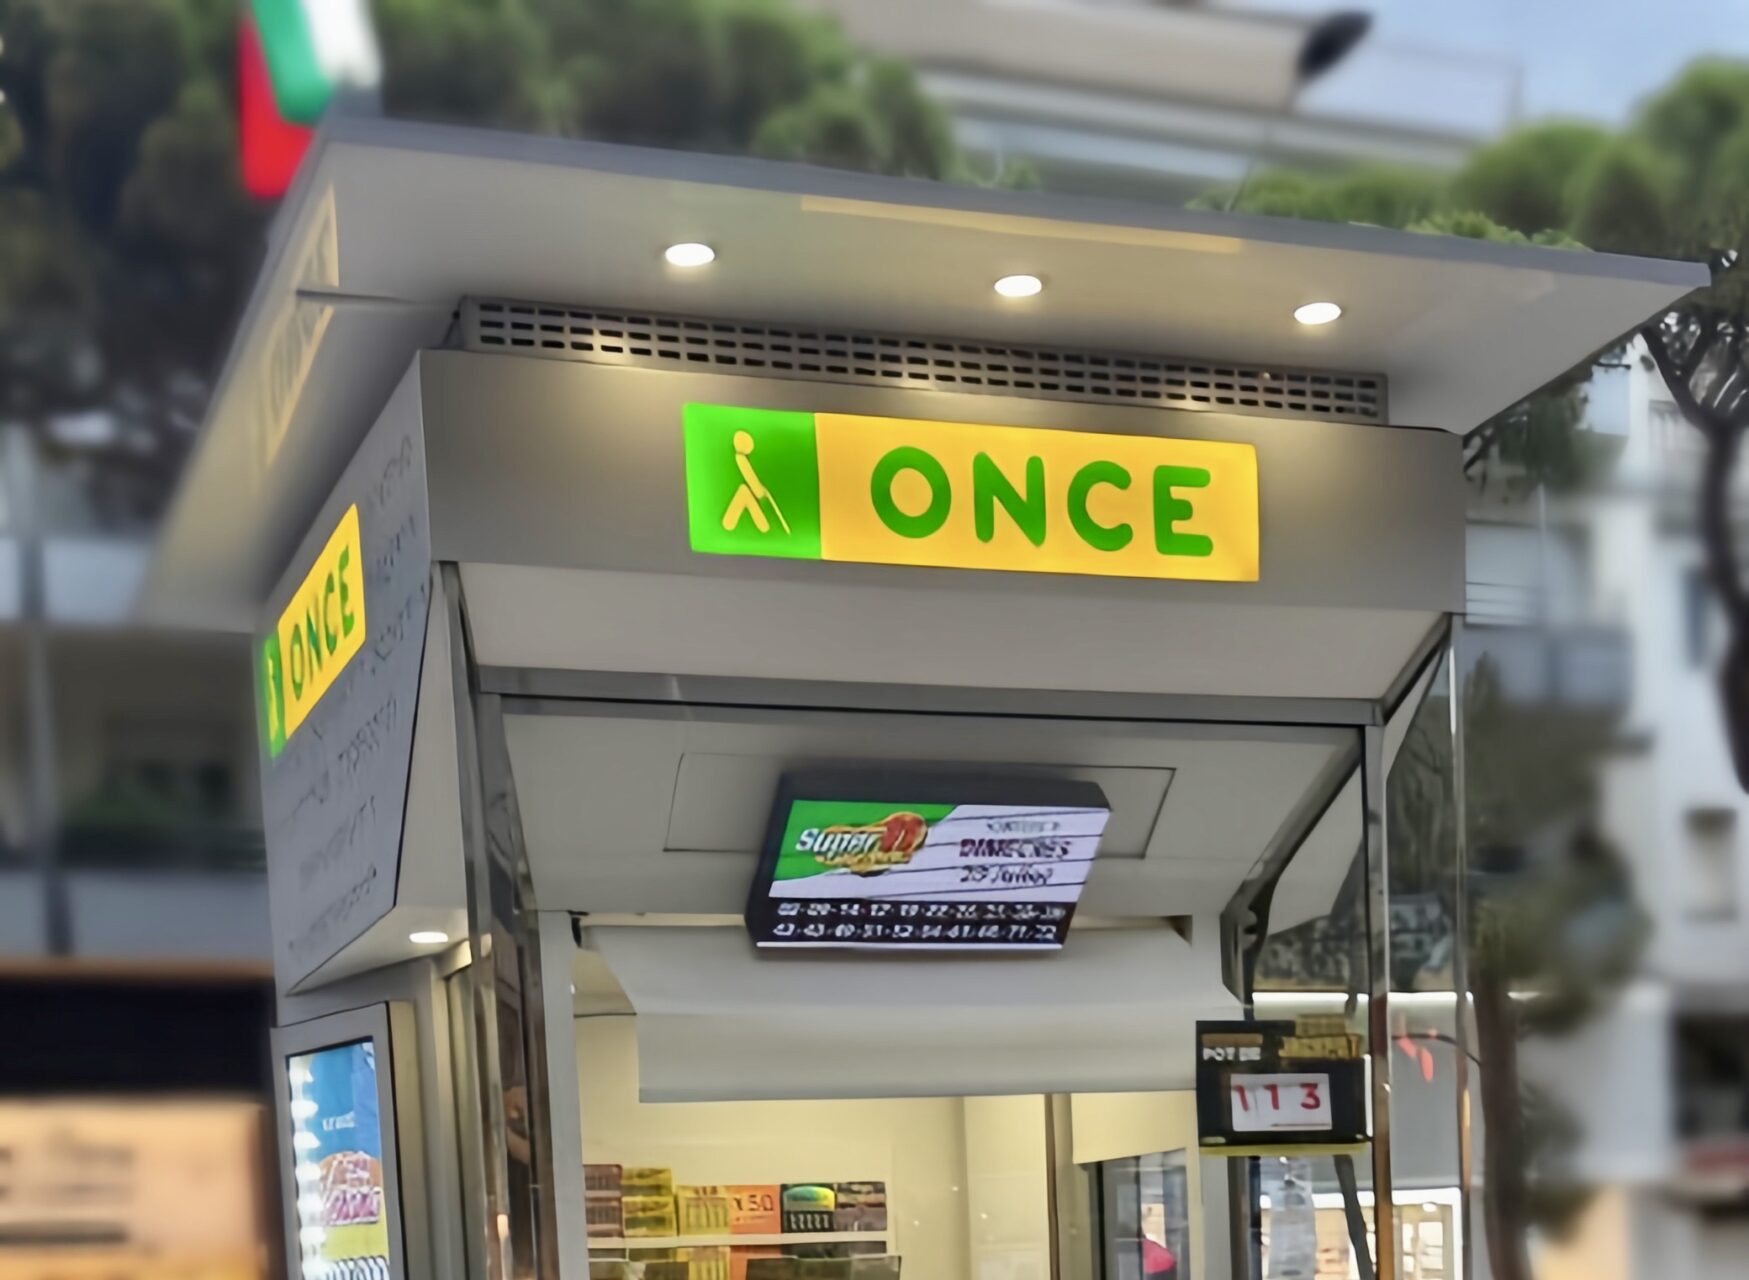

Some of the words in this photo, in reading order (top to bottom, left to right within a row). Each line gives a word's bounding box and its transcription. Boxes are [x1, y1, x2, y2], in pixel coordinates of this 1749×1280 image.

[870, 446, 1214, 557] ONCE
[290, 545, 354, 702] ONCE
[795, 828, 881, 860] Super
